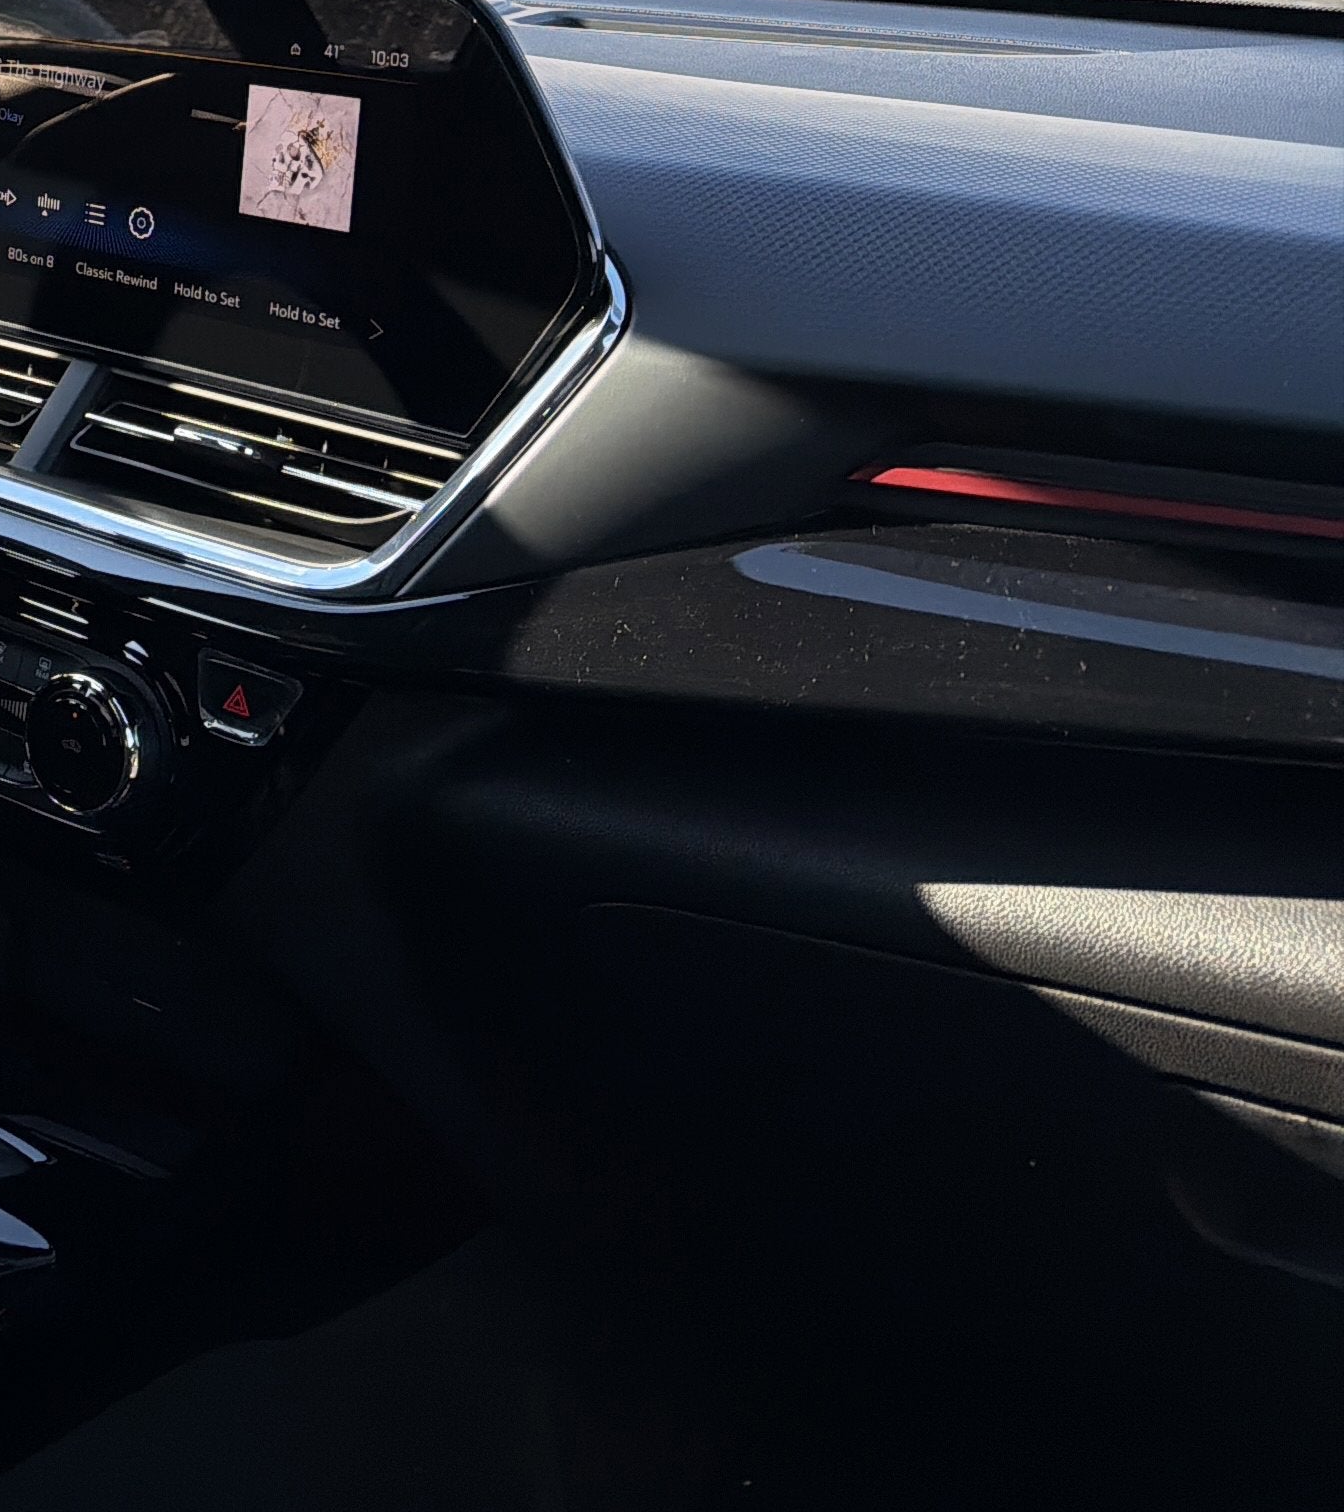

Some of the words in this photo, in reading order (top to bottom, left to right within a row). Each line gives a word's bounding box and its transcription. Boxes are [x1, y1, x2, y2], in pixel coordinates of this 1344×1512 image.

[371, 50, 409, 68] 10:03
[6, 59, 34, 78] The
[38, 63, 107, 93] Highway
[7, 247, 28, 263] 80s
[30, 255, 44, 266] on
[46, 255, 55, 268] 8
[75, 261, 114, 281] Classic
[116, 269, 158, 290] Rewind
[174, 282, 202, 300] Hold
[204, 289, 218, 303] to
[219, 291, 241, 309] Set
[269, 301, 299, 321] Hold
[302, 309, 316, 324] to
[318, 312, 341, 330] Set
